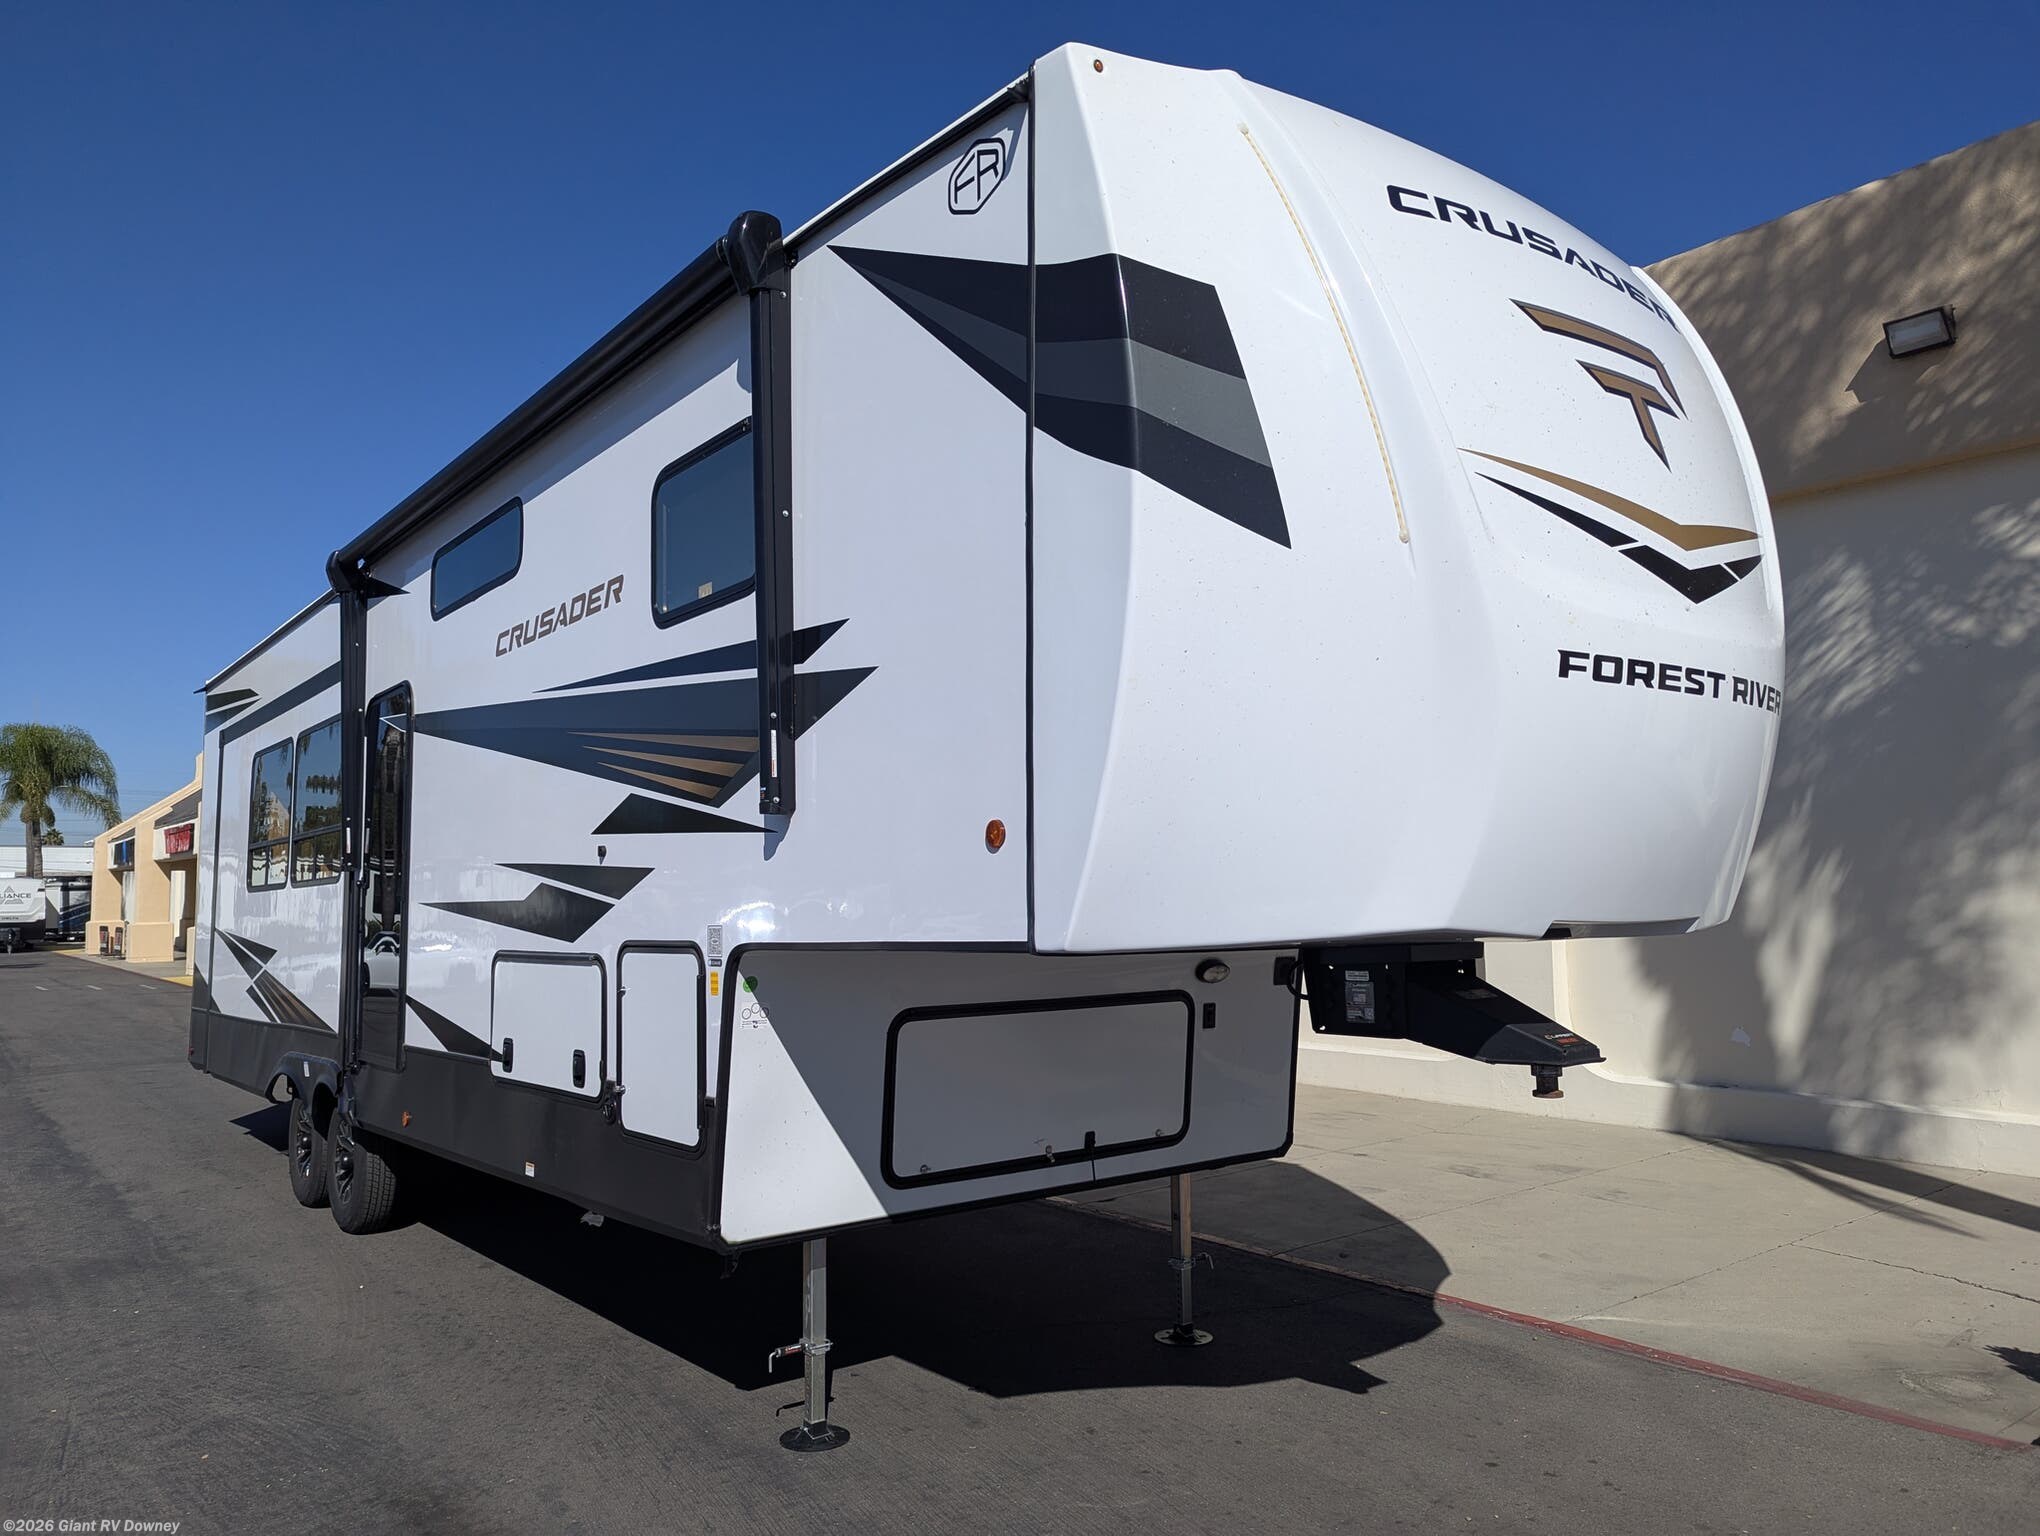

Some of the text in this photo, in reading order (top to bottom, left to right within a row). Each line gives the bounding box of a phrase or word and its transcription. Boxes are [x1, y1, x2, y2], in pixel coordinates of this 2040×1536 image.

[1386, 184, 1682, 335] CRUSADER
[495, 574, 625, 658] CRUSADER
[1557, 648, 1783, 716] FOREST RIVER
